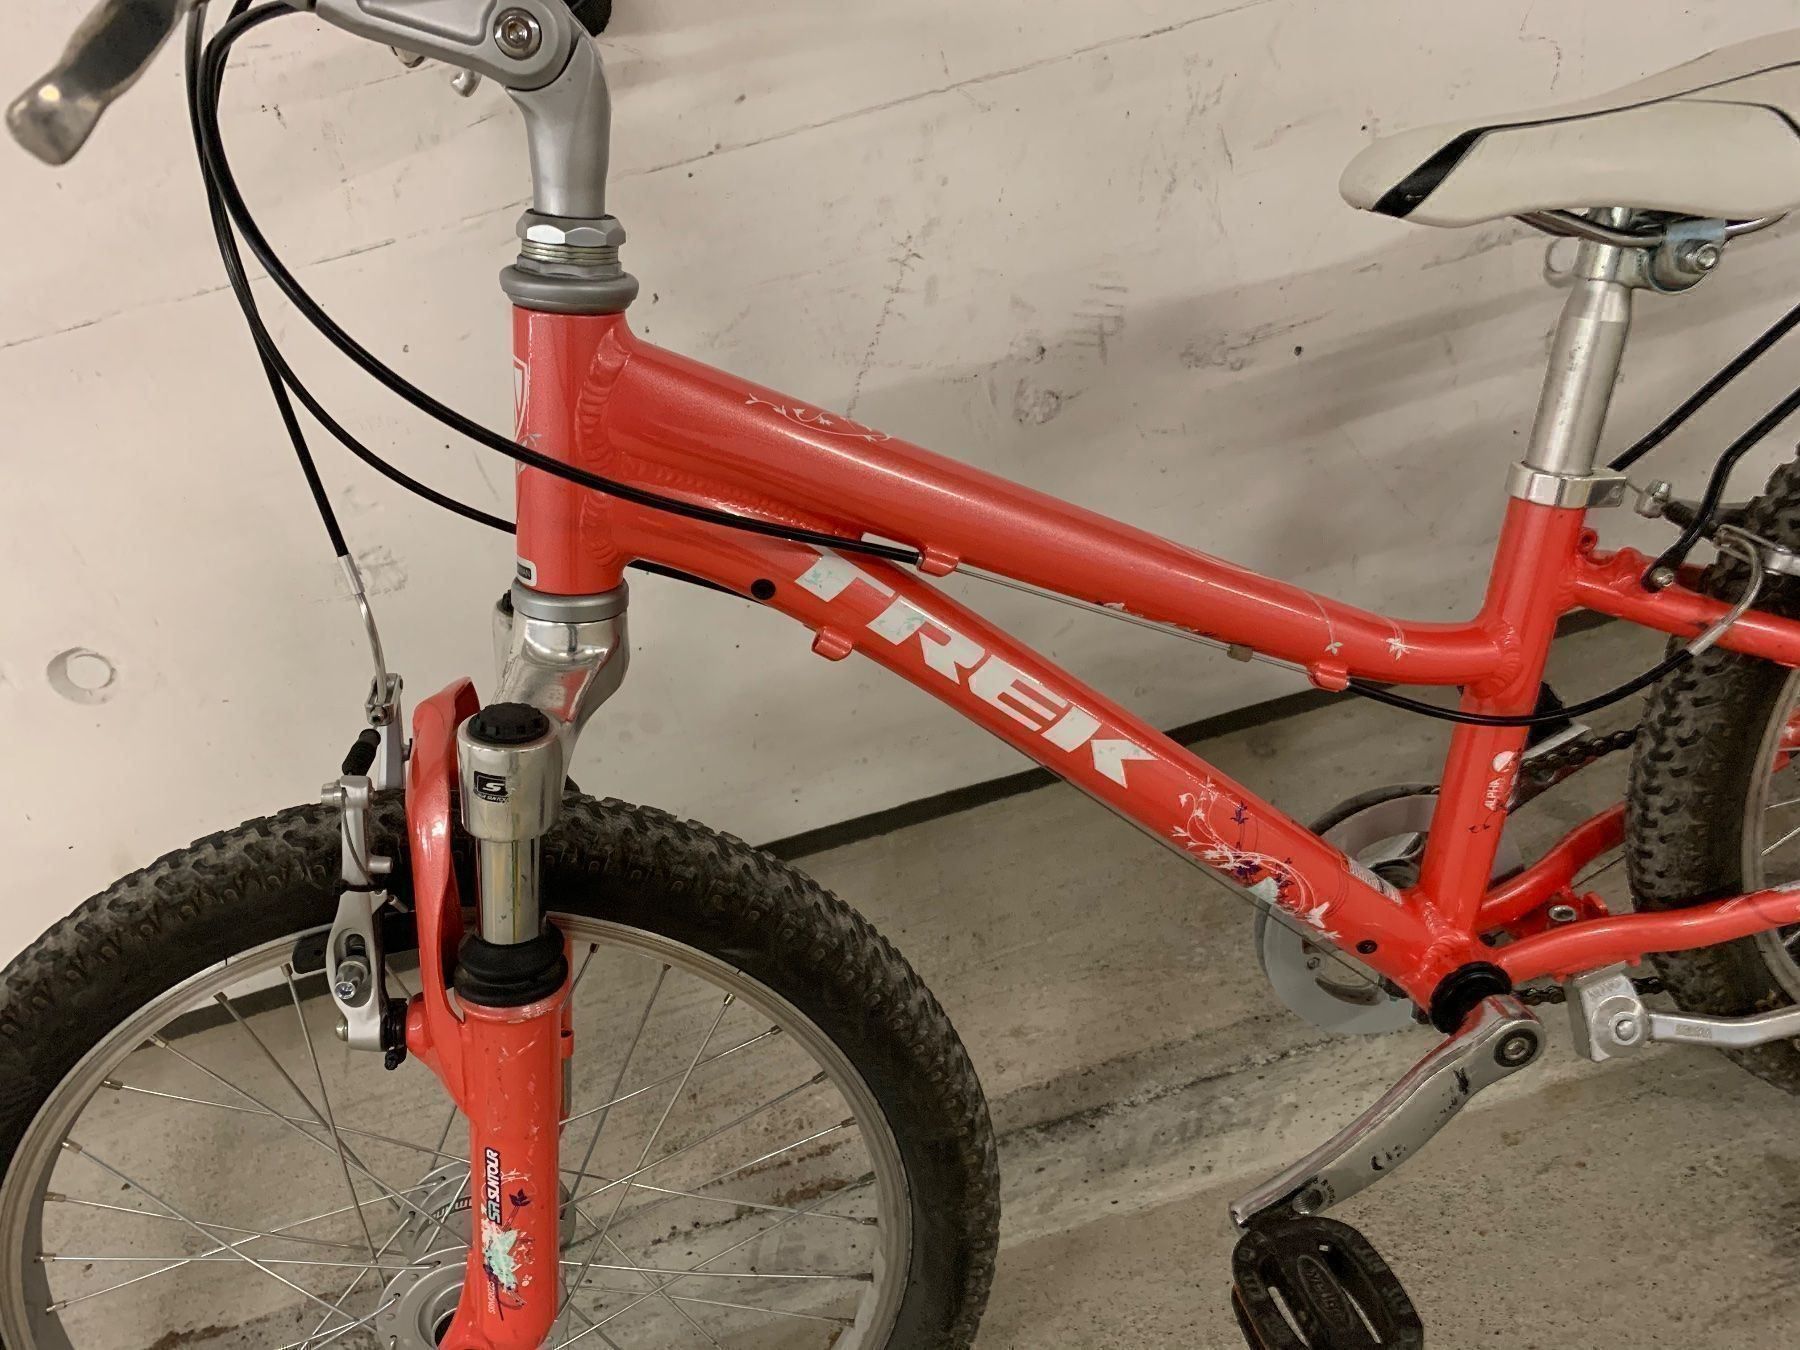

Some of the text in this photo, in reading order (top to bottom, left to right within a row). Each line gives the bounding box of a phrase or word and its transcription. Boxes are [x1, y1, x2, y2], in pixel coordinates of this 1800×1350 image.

[795, 544, 1158, 789] TREK
[1484, 777, 1502, 812] ALPHA
[487, 1149, 499, 1202] SUNTOUR
